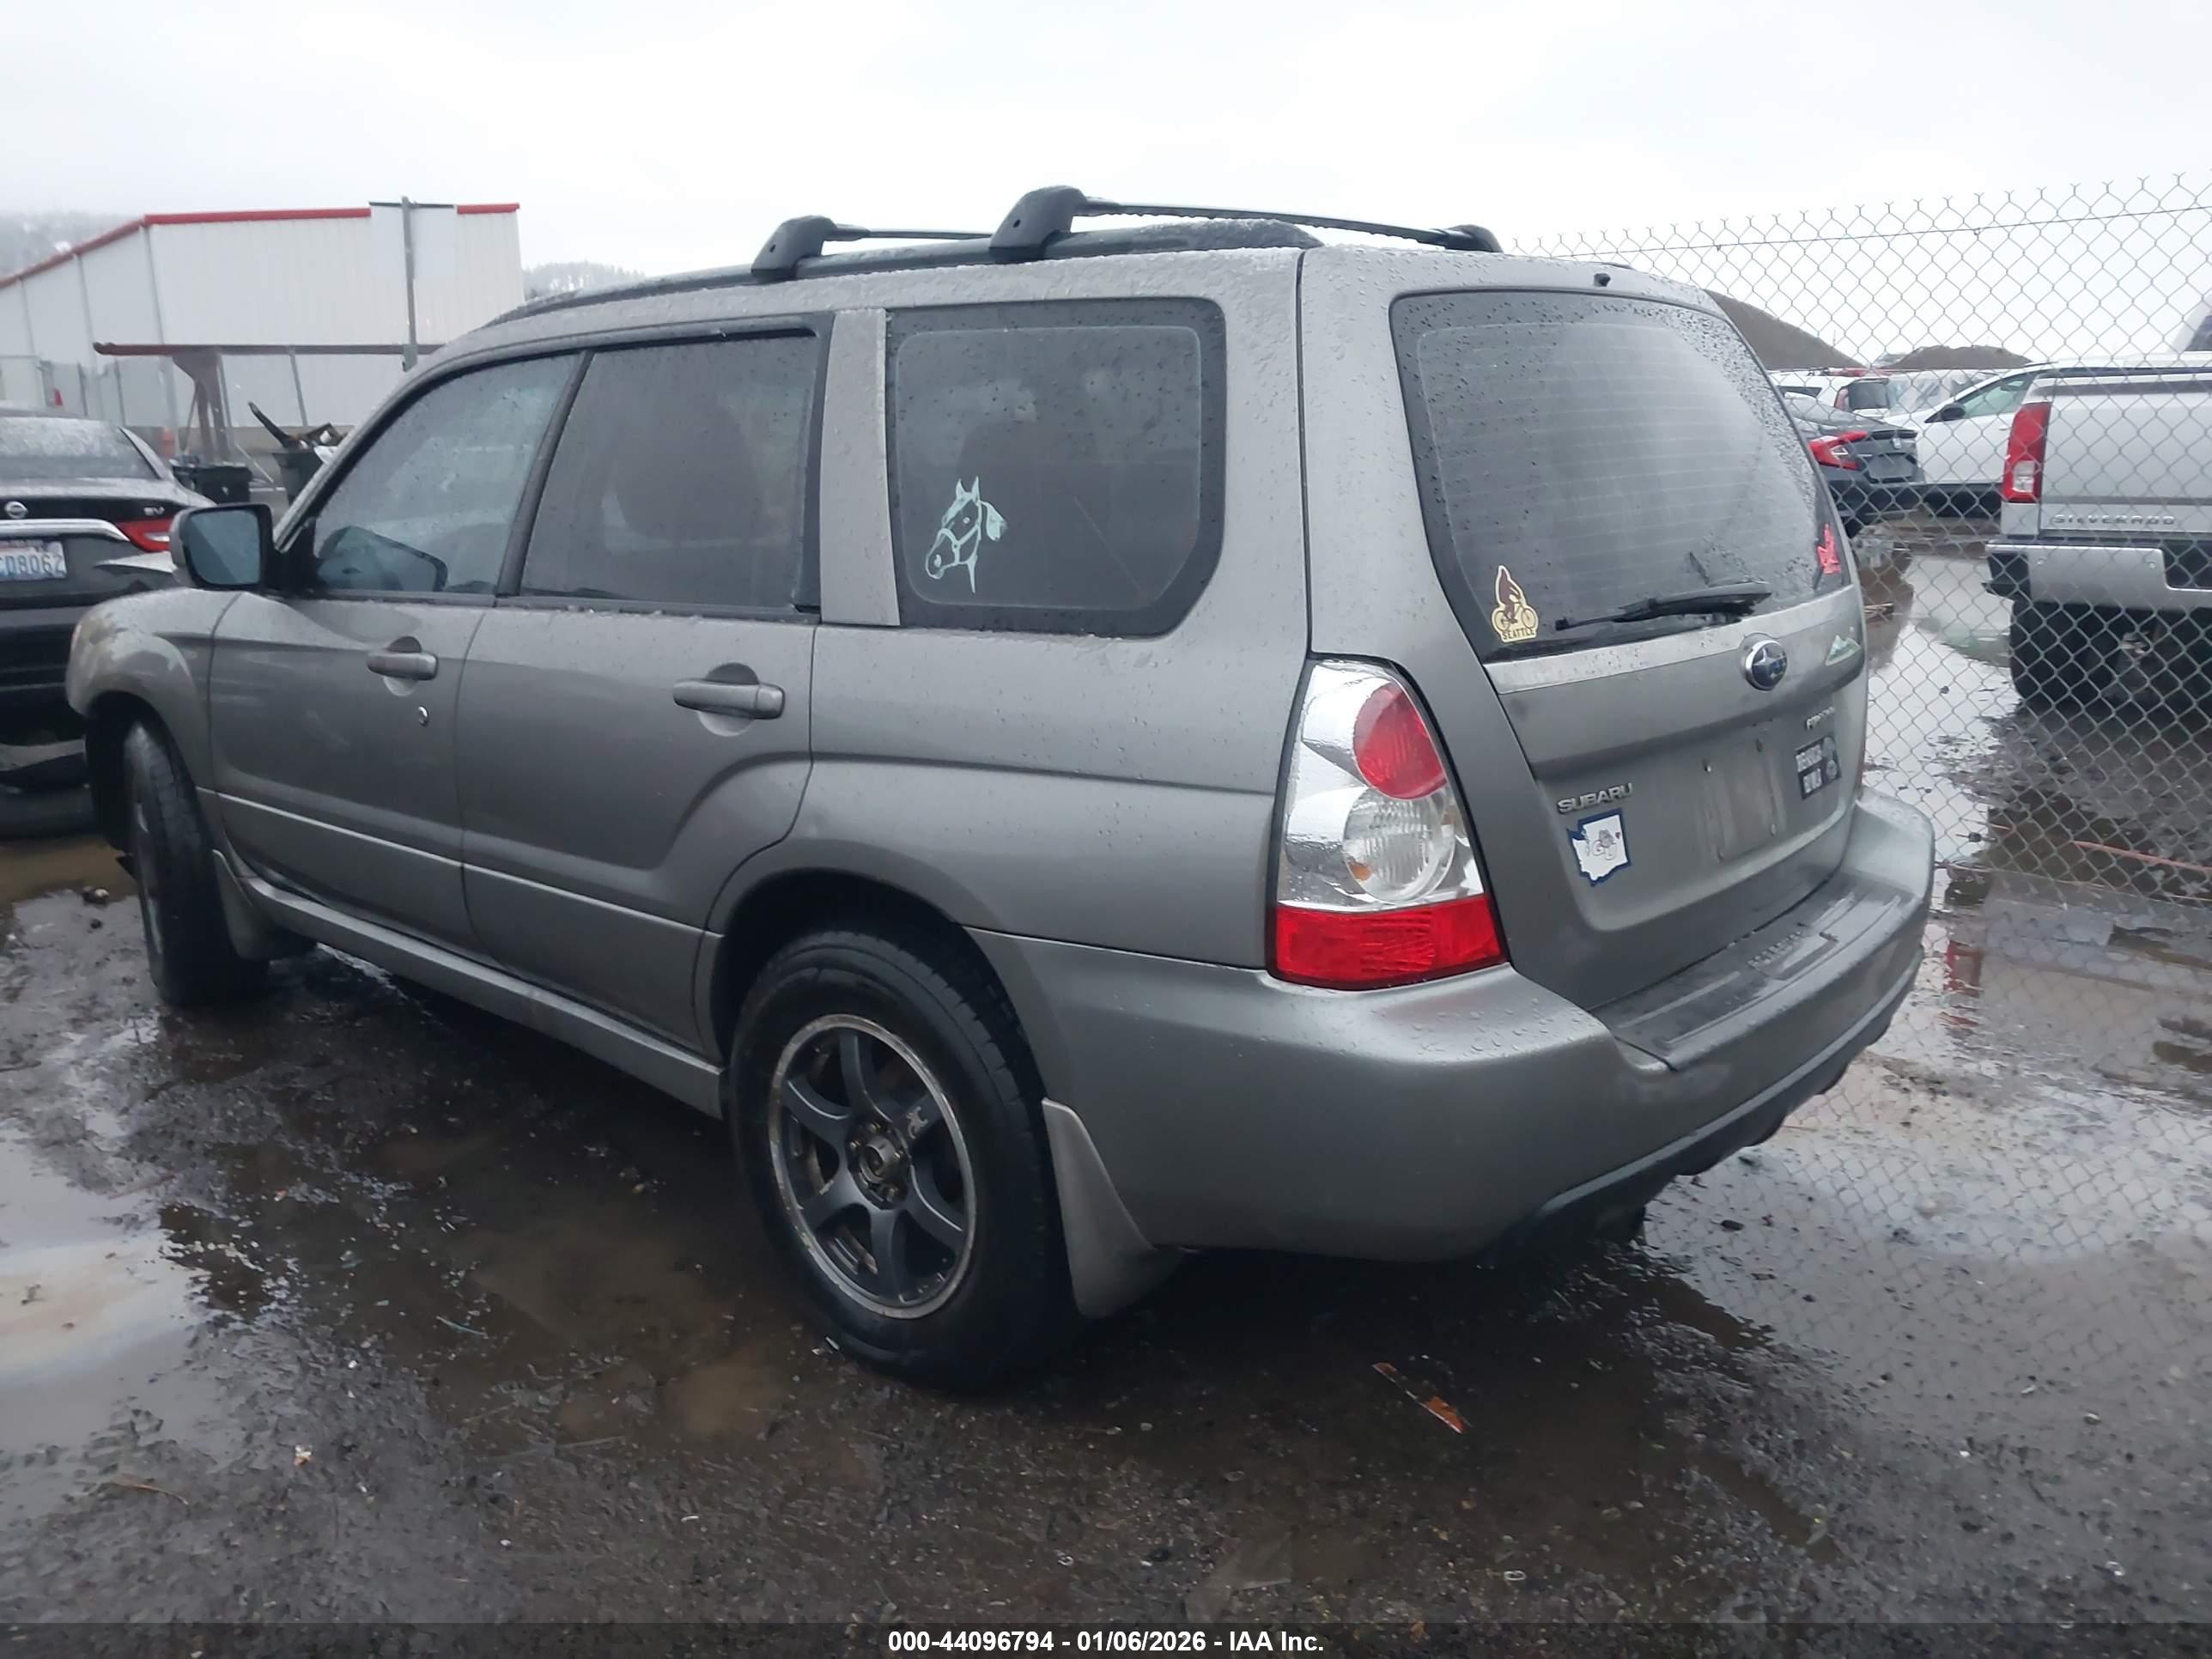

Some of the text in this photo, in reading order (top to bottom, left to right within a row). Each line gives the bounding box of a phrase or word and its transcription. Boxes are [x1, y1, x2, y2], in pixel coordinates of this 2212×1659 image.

[2053, 514, 2176, 526] SILVERADO
[1502, 628, 1535, 640] SEATTLE
[1557, 782, 1633, 814] SUBARU
